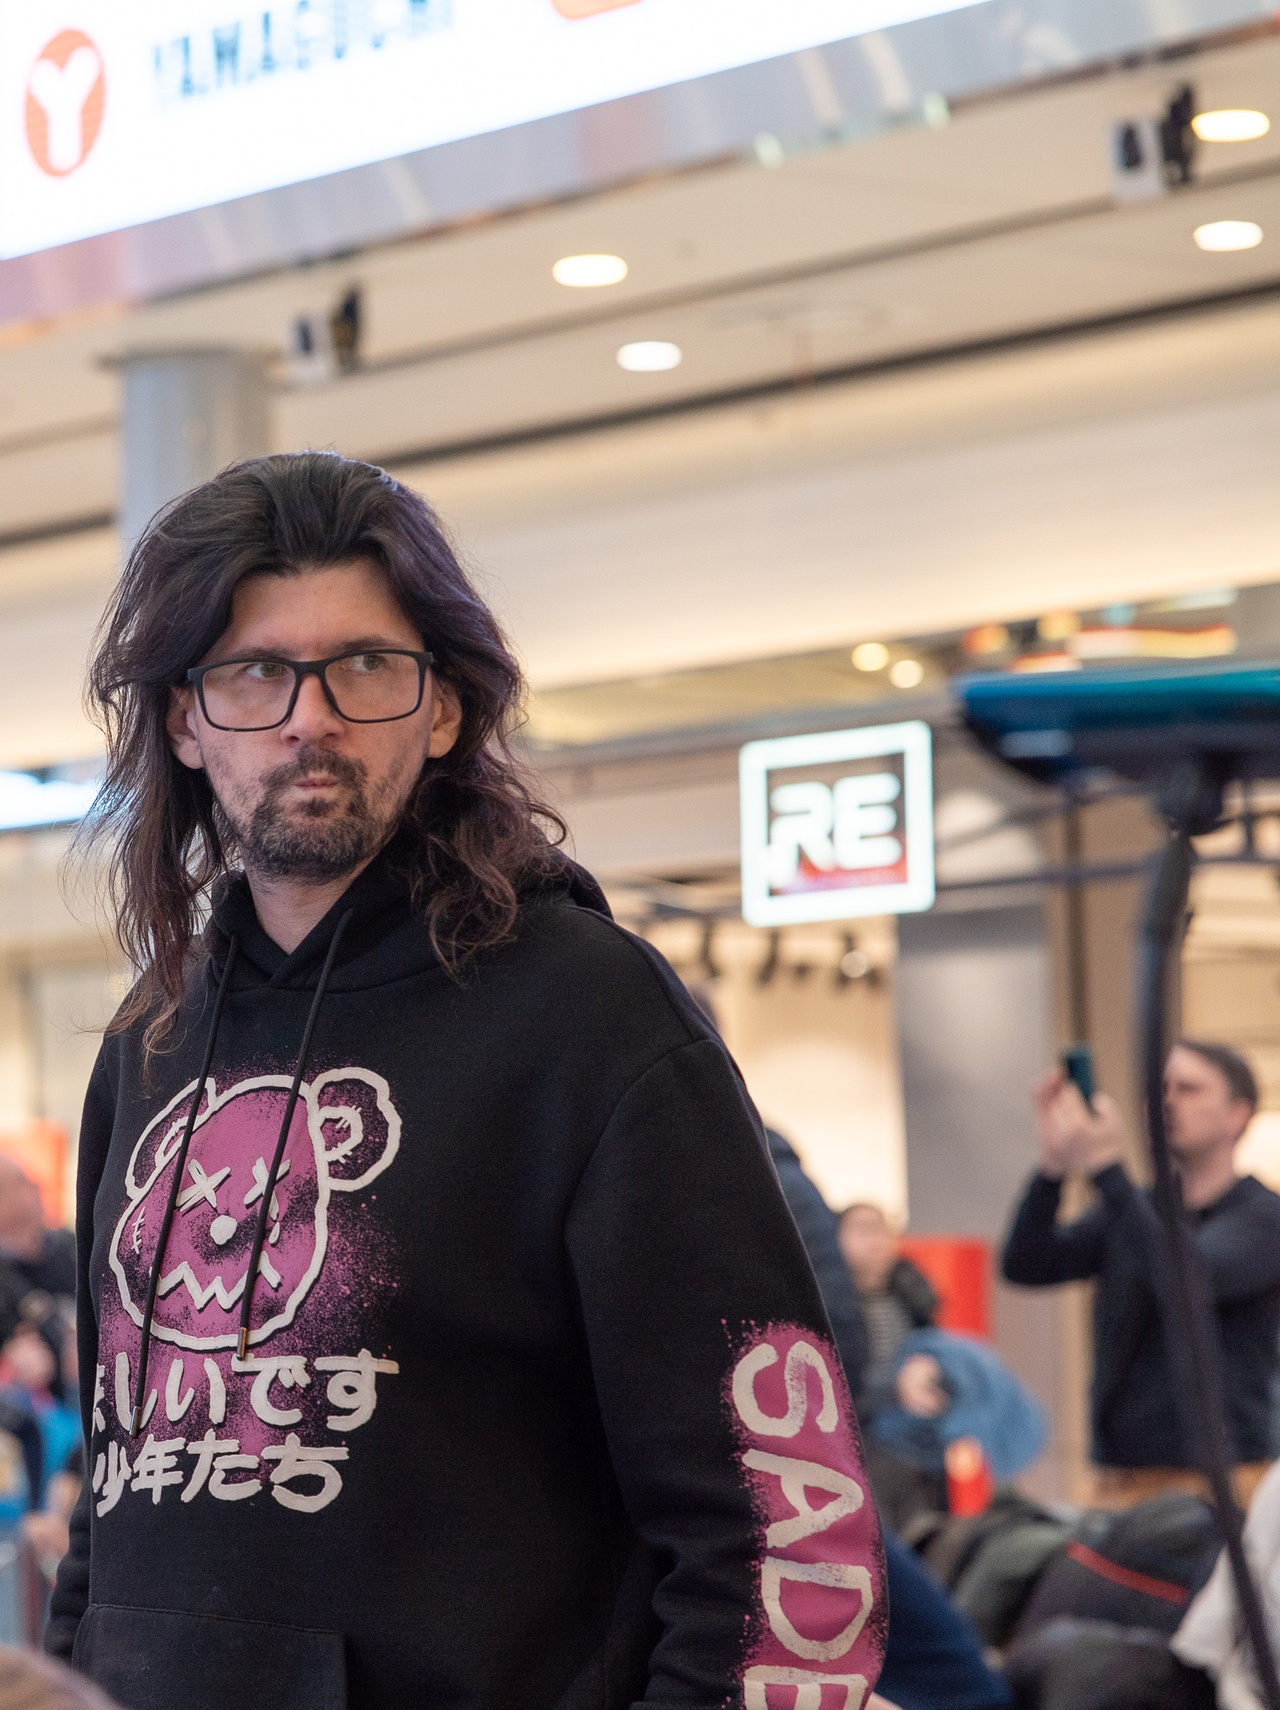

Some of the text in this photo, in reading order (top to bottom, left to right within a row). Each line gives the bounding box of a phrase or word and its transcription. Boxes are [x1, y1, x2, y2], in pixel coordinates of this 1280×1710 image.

[767, 772, 903, 888] RE
[92, 1427, 350, 1518] 少年たち
